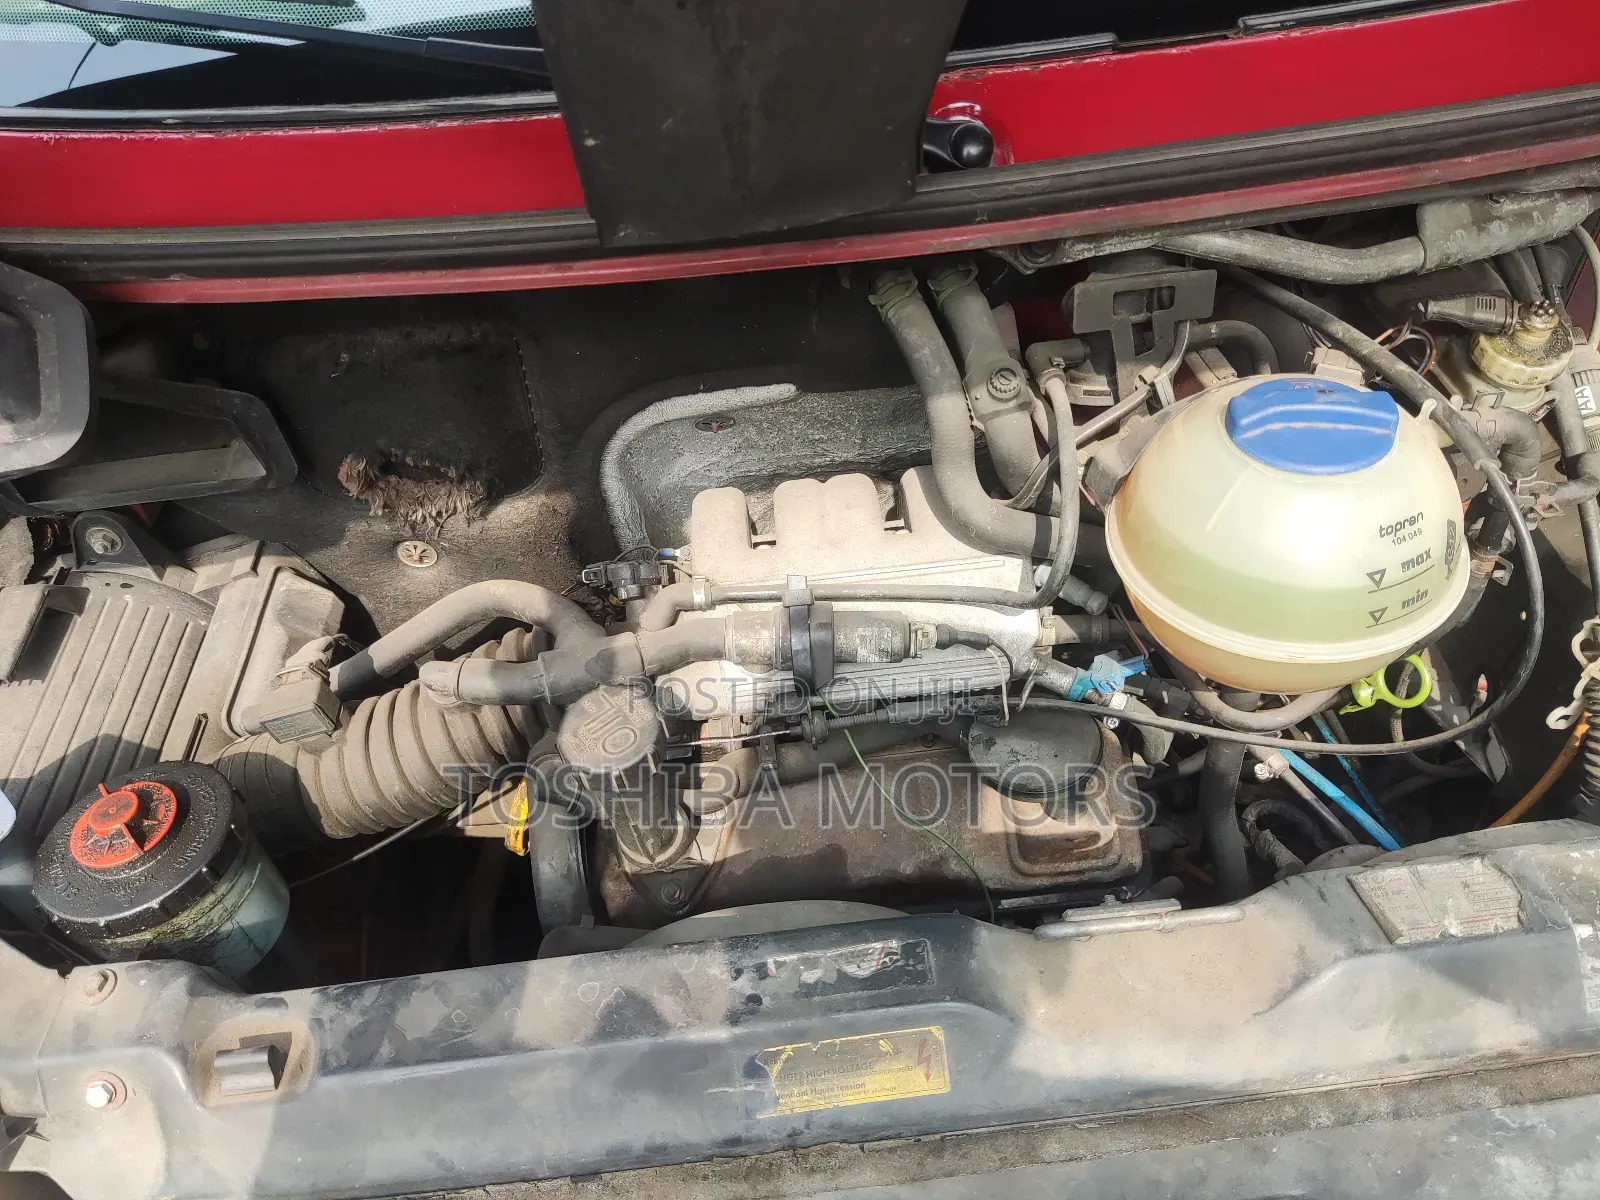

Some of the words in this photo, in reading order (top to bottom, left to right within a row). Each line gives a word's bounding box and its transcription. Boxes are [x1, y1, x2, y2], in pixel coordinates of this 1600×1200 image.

[1378, 511, 1424, 538] topran
[1391, 534, 1407, 547] 104
[1401, 547, 1433, 573] max
[1401, 589, 1429, 610] min
[583, 692, 638, 756] OIL
[806, 1068, 830, 1079] HIGH
[831, 1062, 874, 1076] VOLTAGE
[837, 1081, 866, 1092] tension
